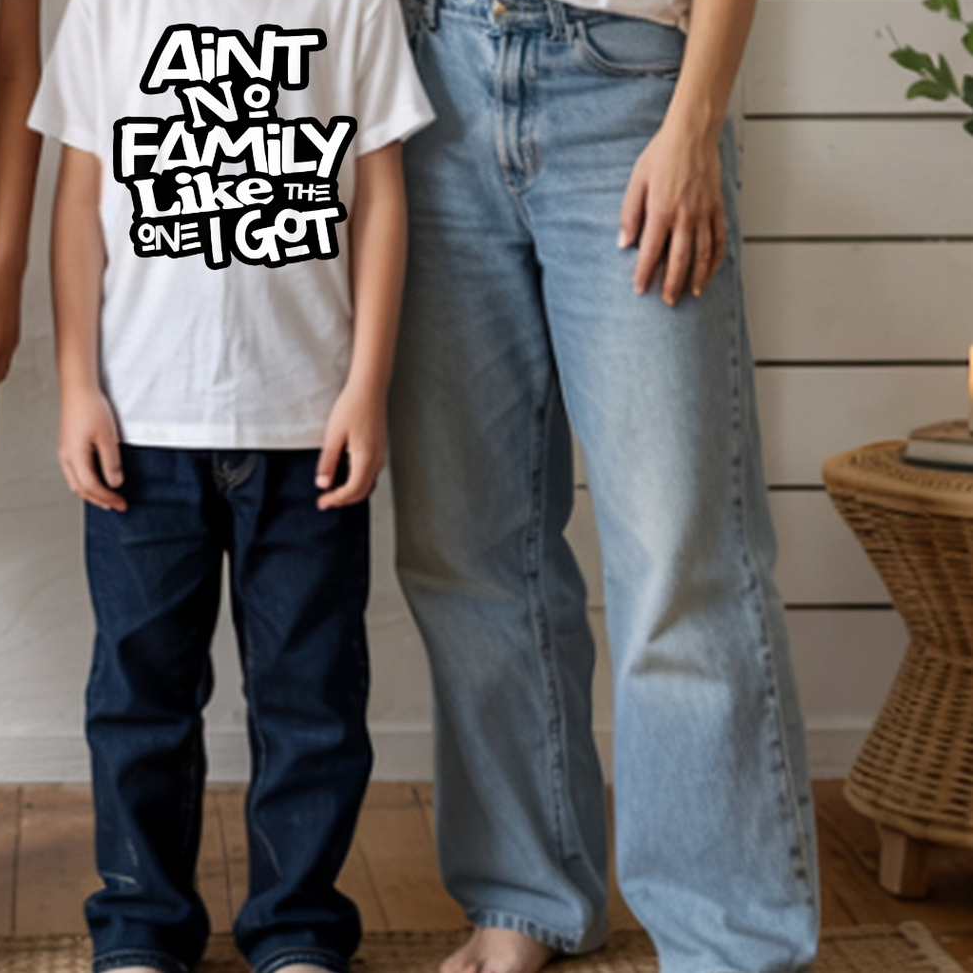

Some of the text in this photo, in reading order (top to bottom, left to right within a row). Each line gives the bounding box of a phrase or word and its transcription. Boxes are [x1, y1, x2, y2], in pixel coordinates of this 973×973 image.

[132, 171, 332, 219] Like THE
[136, 221, 203, 253] ONE
[234, 206, 341, 263] GOT
